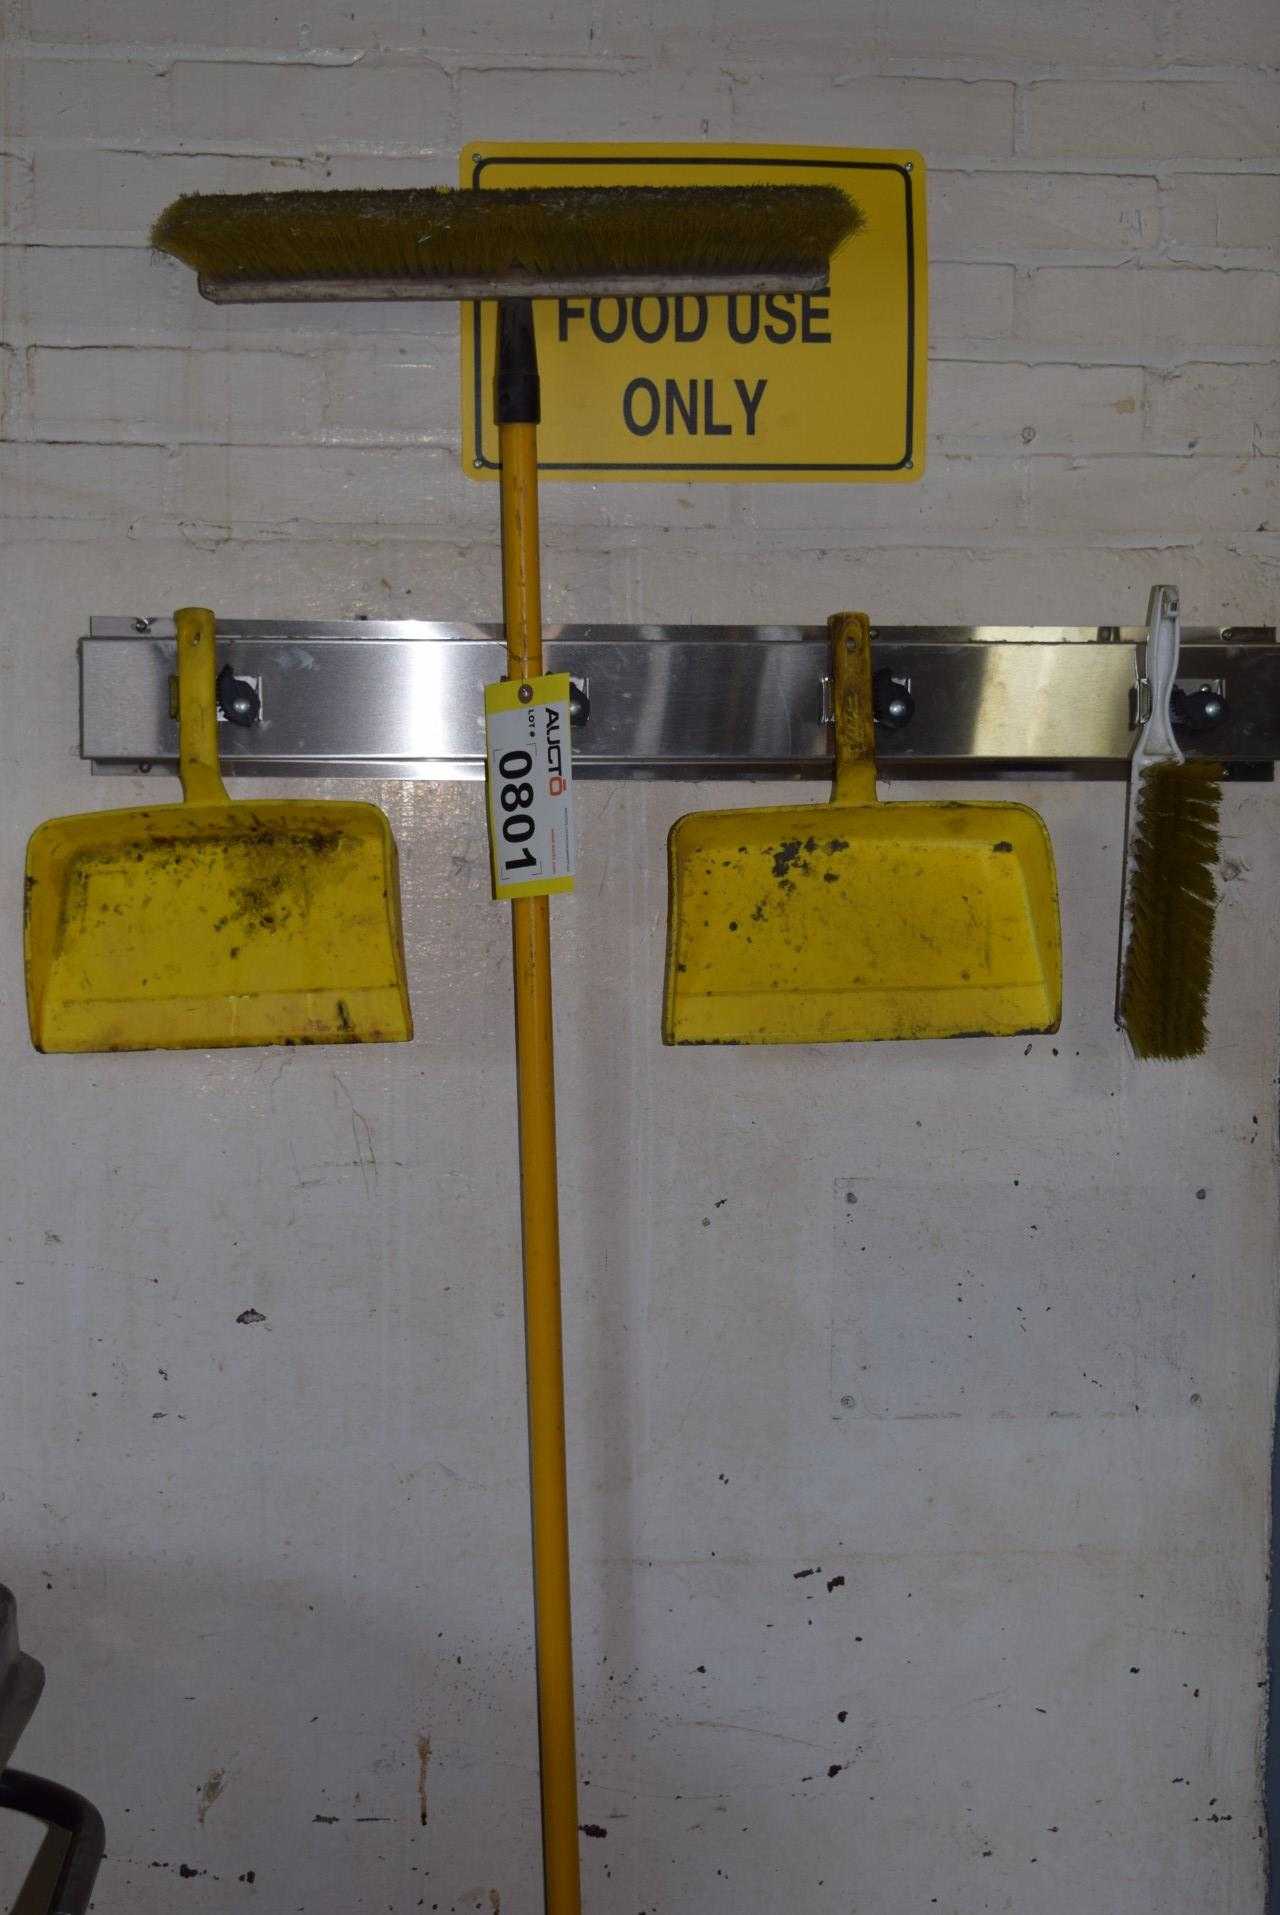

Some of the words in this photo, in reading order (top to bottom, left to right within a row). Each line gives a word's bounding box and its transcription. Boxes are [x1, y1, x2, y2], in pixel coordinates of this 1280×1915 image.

[558, 294, 708, 343] FOOD
[727, 288, 831, 344] USE
[622, 377, 768, 436] ONLY
[528, 709, 536, 728] LOT
[499, 750, 537, 870] 0801
